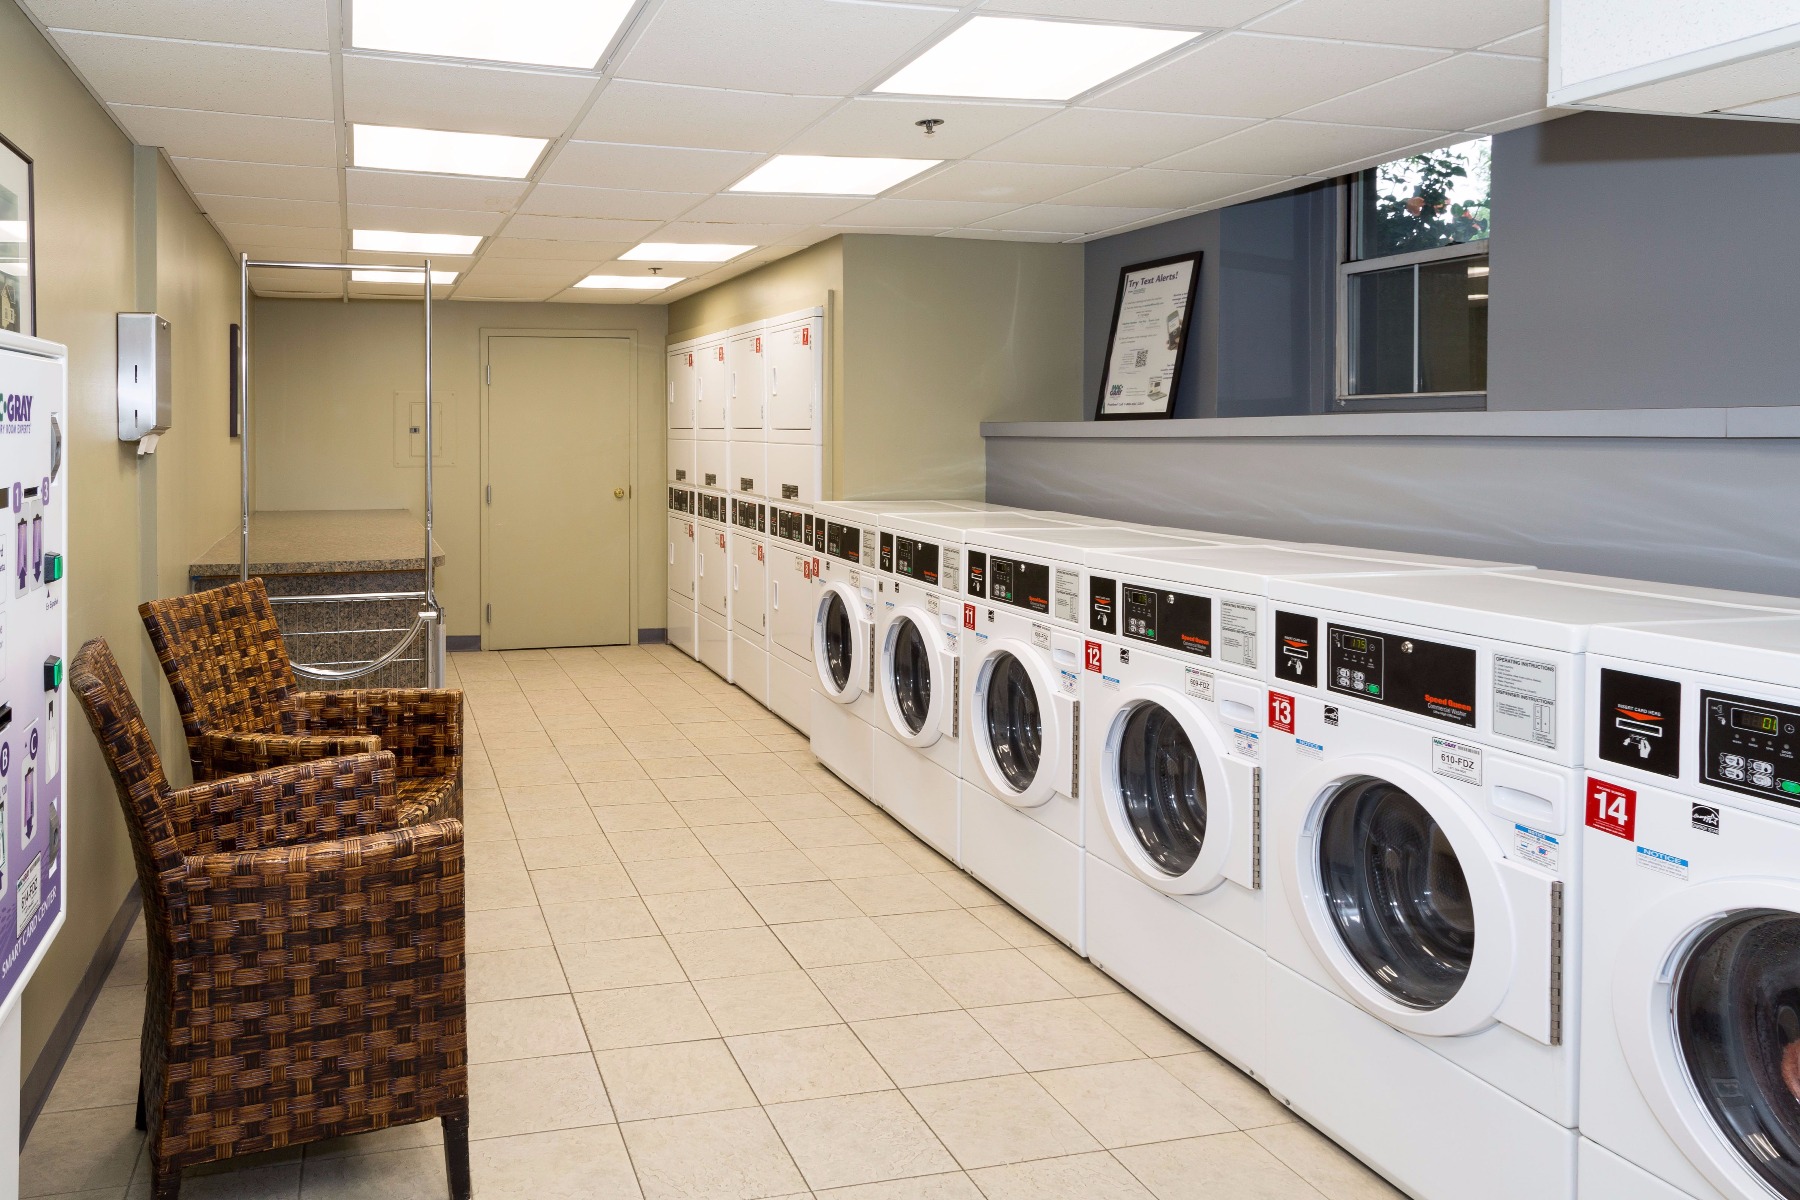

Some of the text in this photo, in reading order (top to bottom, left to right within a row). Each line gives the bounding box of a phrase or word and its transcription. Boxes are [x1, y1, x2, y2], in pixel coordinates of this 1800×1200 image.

[1129, 271, 1179, 289] Try Text Alerts!
[43, 481, 48, 501] 3
[965, 609, 973, 624] 11
[1087, 647, 1100, 666] 12
[1496, 656, 1555, 672] OPERATING INSTRUCTIONS
[1424, 694, 1471, 711] Speed Queen
[1521, 694, 1554, 705] INSTRUCTIONS
[1272, 700, 1292, 724] 13
[31, 733, 37, 754] C
[2, 748, 8, 771] B
[1441, 753, 1475, 770] 610-FDZ
[1593, 791, 1628, 826] 14
[1643, 848, 1682, 865] NOTICE
[2, 885, 58, 979] SMART CARD CENTER
